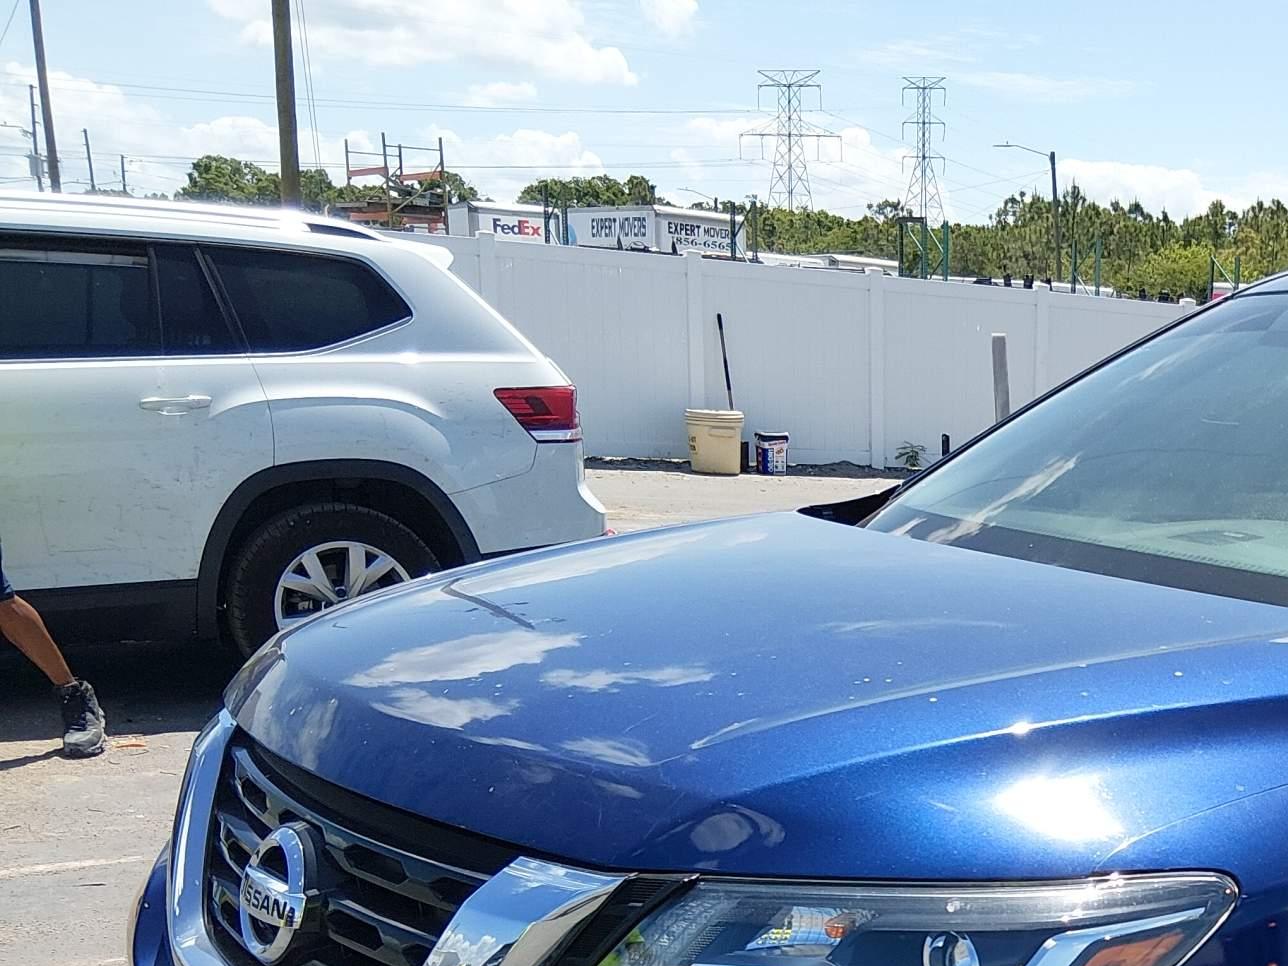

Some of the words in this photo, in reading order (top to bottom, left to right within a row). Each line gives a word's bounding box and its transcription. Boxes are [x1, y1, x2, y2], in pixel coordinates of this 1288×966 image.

[492, 218, 541, 236] FedEx
[591, 217, 617, 238] EXPERT
[618, 216, 647, 238] MOVERS
[667, 221, 702, 237] EXPERT
[703, 226, 731, 239] MOVER
[242, 877, 288, 920] ISSAN
